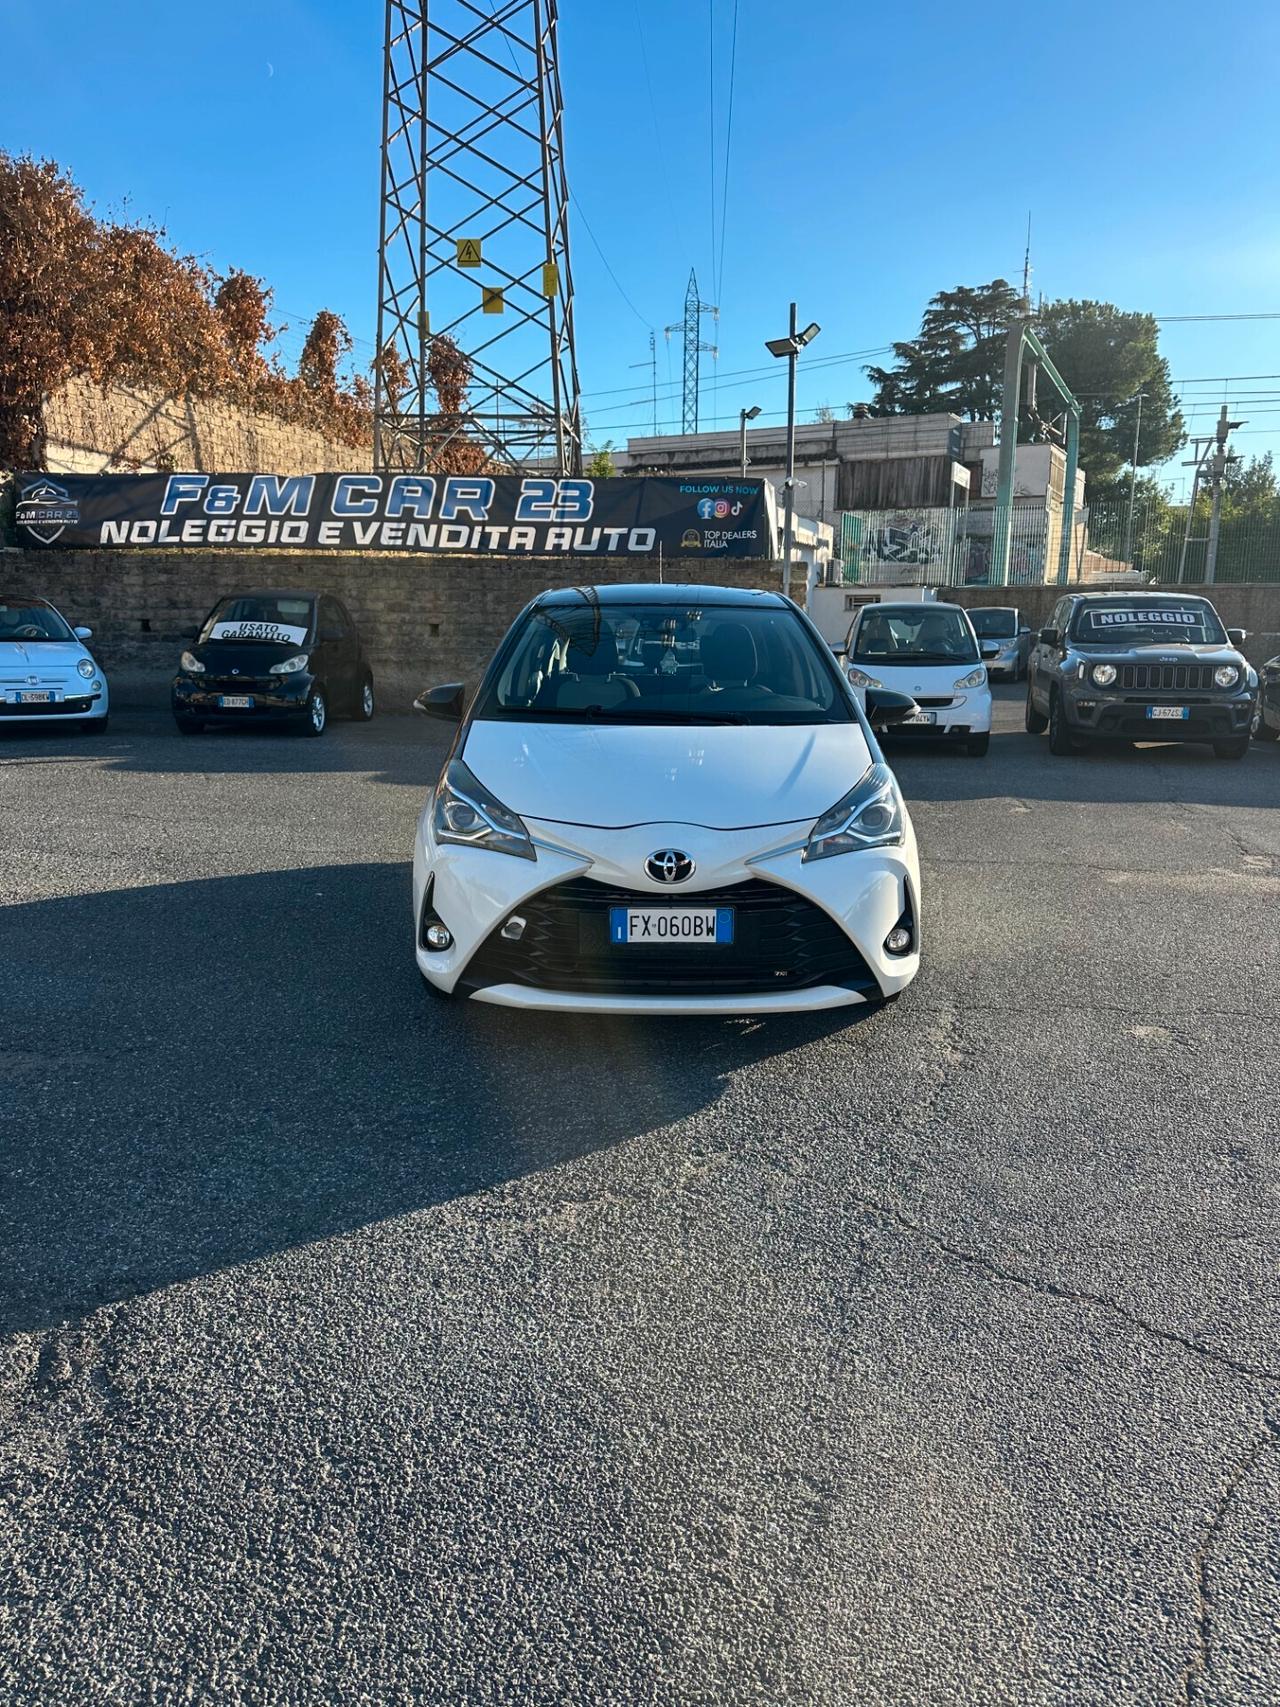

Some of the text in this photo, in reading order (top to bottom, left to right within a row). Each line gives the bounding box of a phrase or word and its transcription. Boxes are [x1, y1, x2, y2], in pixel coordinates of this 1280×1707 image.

[679, 485, 759, 495] FOLLOW US NOW
[160, 474, 594, 522] F&M CAR 23
[38, 511, 63, 519] CAR
[100, 519, 656, 552] NOLEGGIO E VENDITA AUTO
[704, 530, 757, 540] TOP DEALERS
[704, 540, 728, 548] ITALIA
[1100, 612, 1195, 624] NOLEGGIO
[239, 623, 279, 633] USATO
[221, 629, 291, 642] GARANTITO
